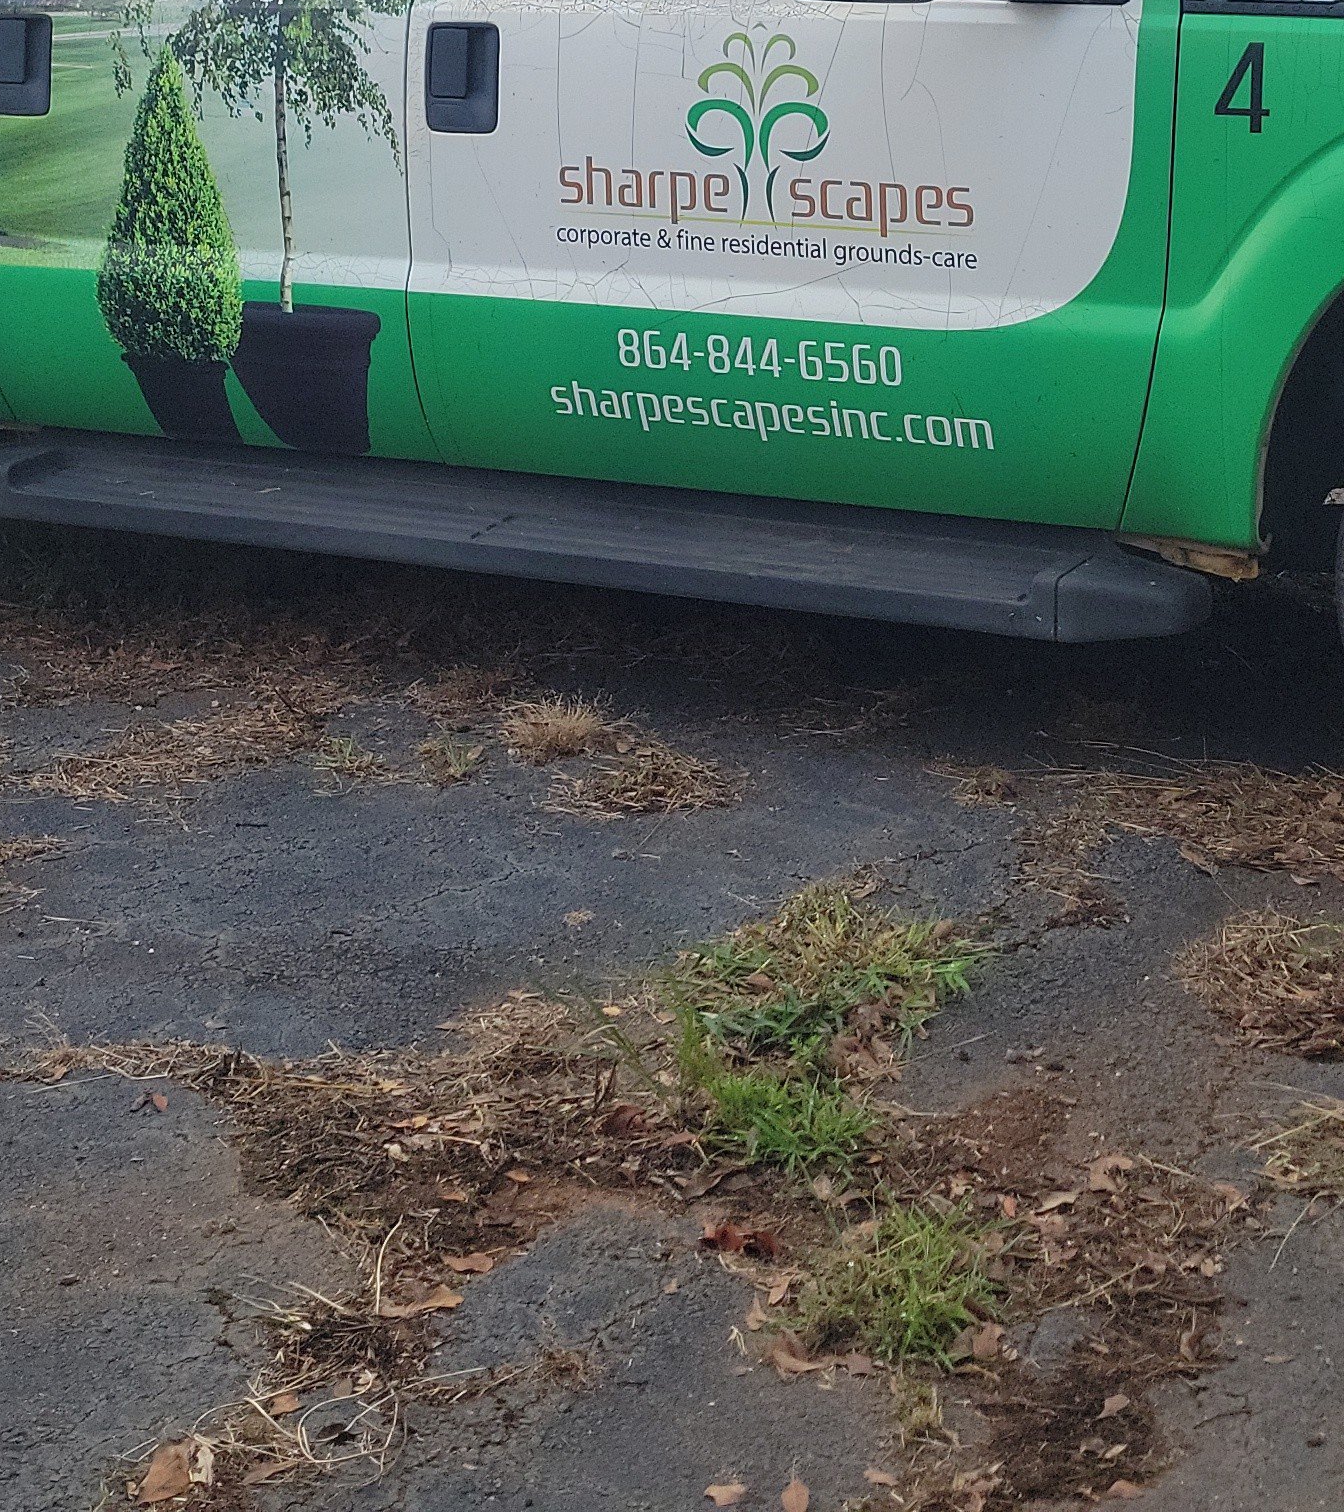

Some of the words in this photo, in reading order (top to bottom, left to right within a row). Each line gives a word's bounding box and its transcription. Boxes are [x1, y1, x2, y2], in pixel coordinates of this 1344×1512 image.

[1214, 41, 1270, 133] 4
[559, 155, 730, 224] sharpe
[789, 178, 974, 238] scapes
[556, 227, 651, 249] corporate
[656, 228, 672, 249] &
[676, 229, 715, 252] fine
[721, 234, 827, 259] residential
[833, 243, 978, 269] grounds-care
[617, 329, 902, 387] 864-844-6560
[550, 381, 995, 450] sharpescapesinc.com
